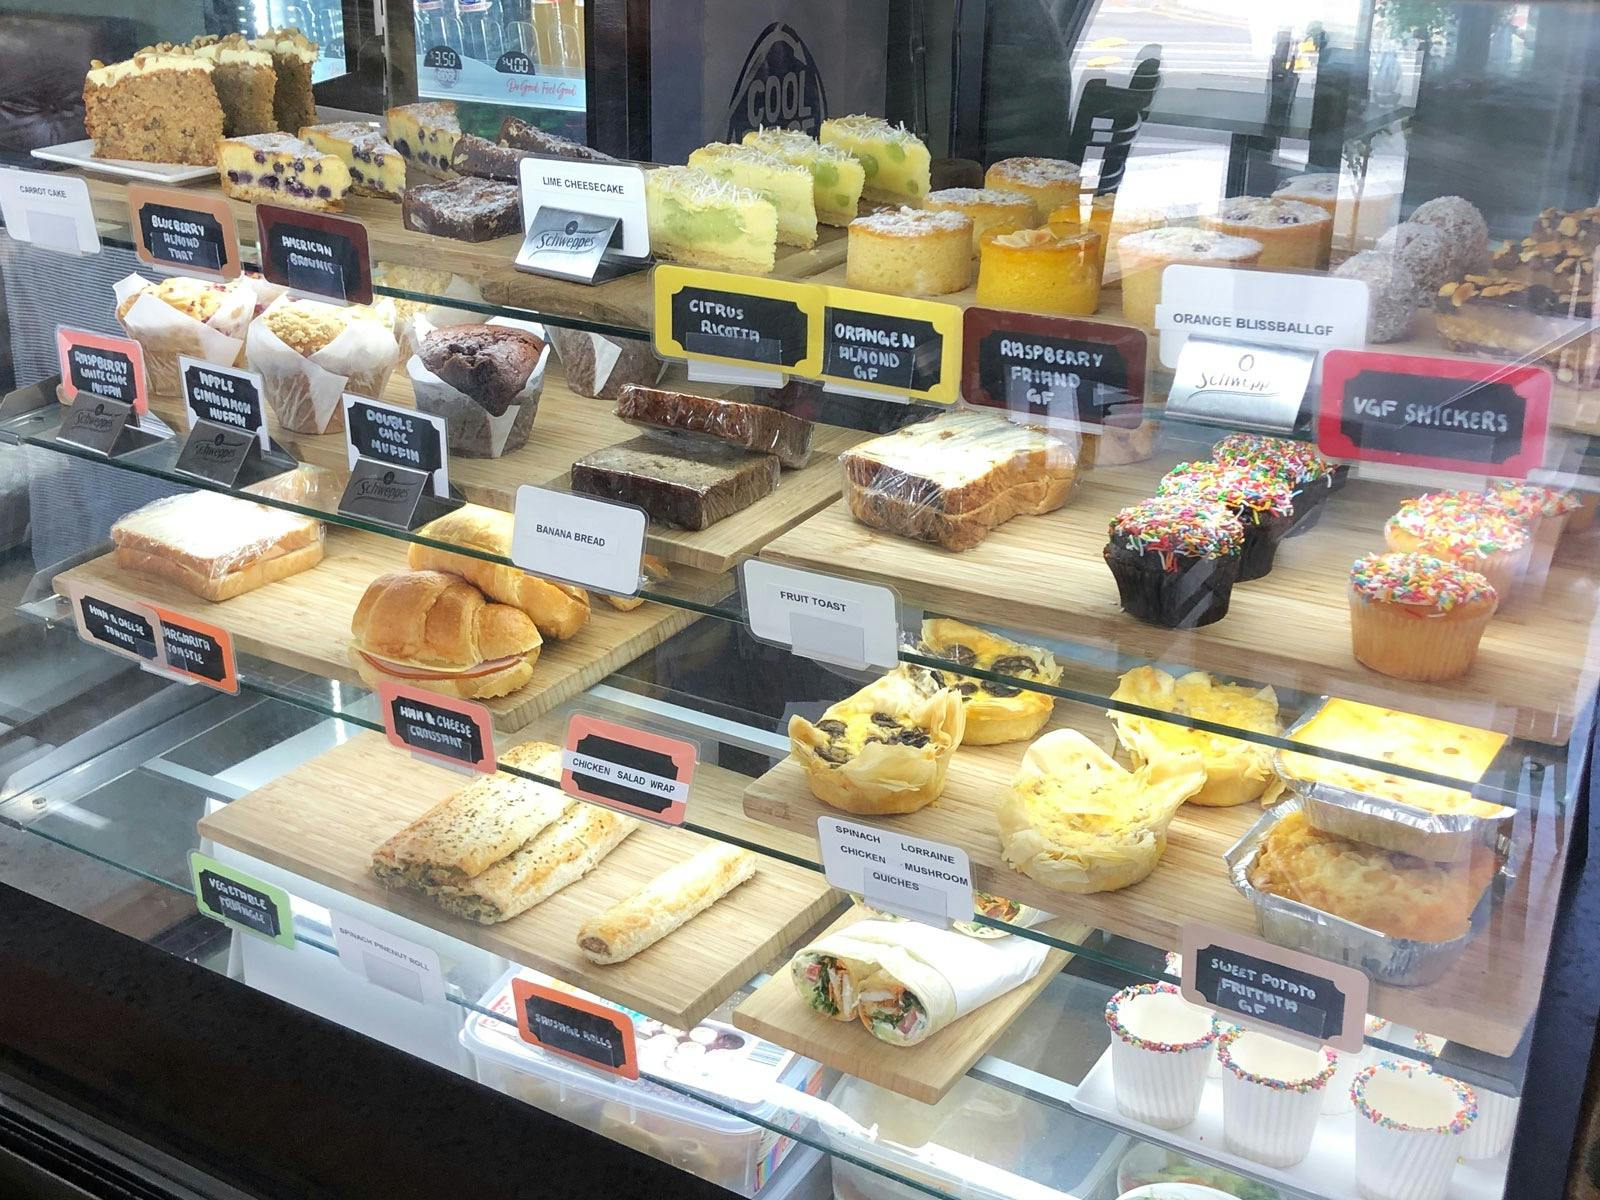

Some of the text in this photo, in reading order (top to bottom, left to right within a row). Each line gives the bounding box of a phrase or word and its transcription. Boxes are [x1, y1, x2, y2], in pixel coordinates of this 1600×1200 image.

[502, 57, 529, 74] $4.00
[747, 71, 812, 127] COOL
[19, 185, 67, 199] CARROT CAKE
[542, 176, 625, 195] LIME CHEESECAKE
[281, 235, 333, 257] AMERICAN
[536, 232, 594, 250] Schweppes
[288, 252, 335, 275] BROWNIE
[689, 299, 745, 320] CITRUS
[700, 319, 761, 343] RICOTTA
[1173, 312, 1334, 336] ORANGE BLISSBALLGF
[839, 345, 900, 368] ALMOND
[1000, 339, 1104, 368] RASPBERRY
[199, 371, 235, 394] APPLE
[853, 364, 879, 380] GF
[1010, 366, 1081, 389] FRIAND
[1026, 388, 1056, 406] GF
[209, 407, 247, 428] MUFFIN
[366, 409, 414, 433] DOUBLE
[1352, 396, 1508, 433] VGF SNICKERS
[378, 427, 409, 445] CHOC
[371, 439, 420, 464] MUFFIN
[536, 523, 606, 547] BANANA BREAD
[780, 590, 847, 612] FRUIT TOAST
[400, 705, 425, 722] HAM
[436, 715, 473, 738] CHEESE
[409, 725, 463, 749] CROISSANT
[572, 757, 676, 793] CHICKEN SALAD WRAP
[835, 825, 955, 865] SPINACH LORRAINE
[840, 845, 969, 887] CHICKEN MUSHROOM
[872, 871, 920, 891] QUICHES
[339, 927, 373, 946] SPINACH
[408, 957, 430, 972] ROLL
[1210, 958, 1317, 1001] SWEET POTATO
[1220, 977, 1299, 1014] FRITTATA
[1237, 999, 1268, 1015] GF
